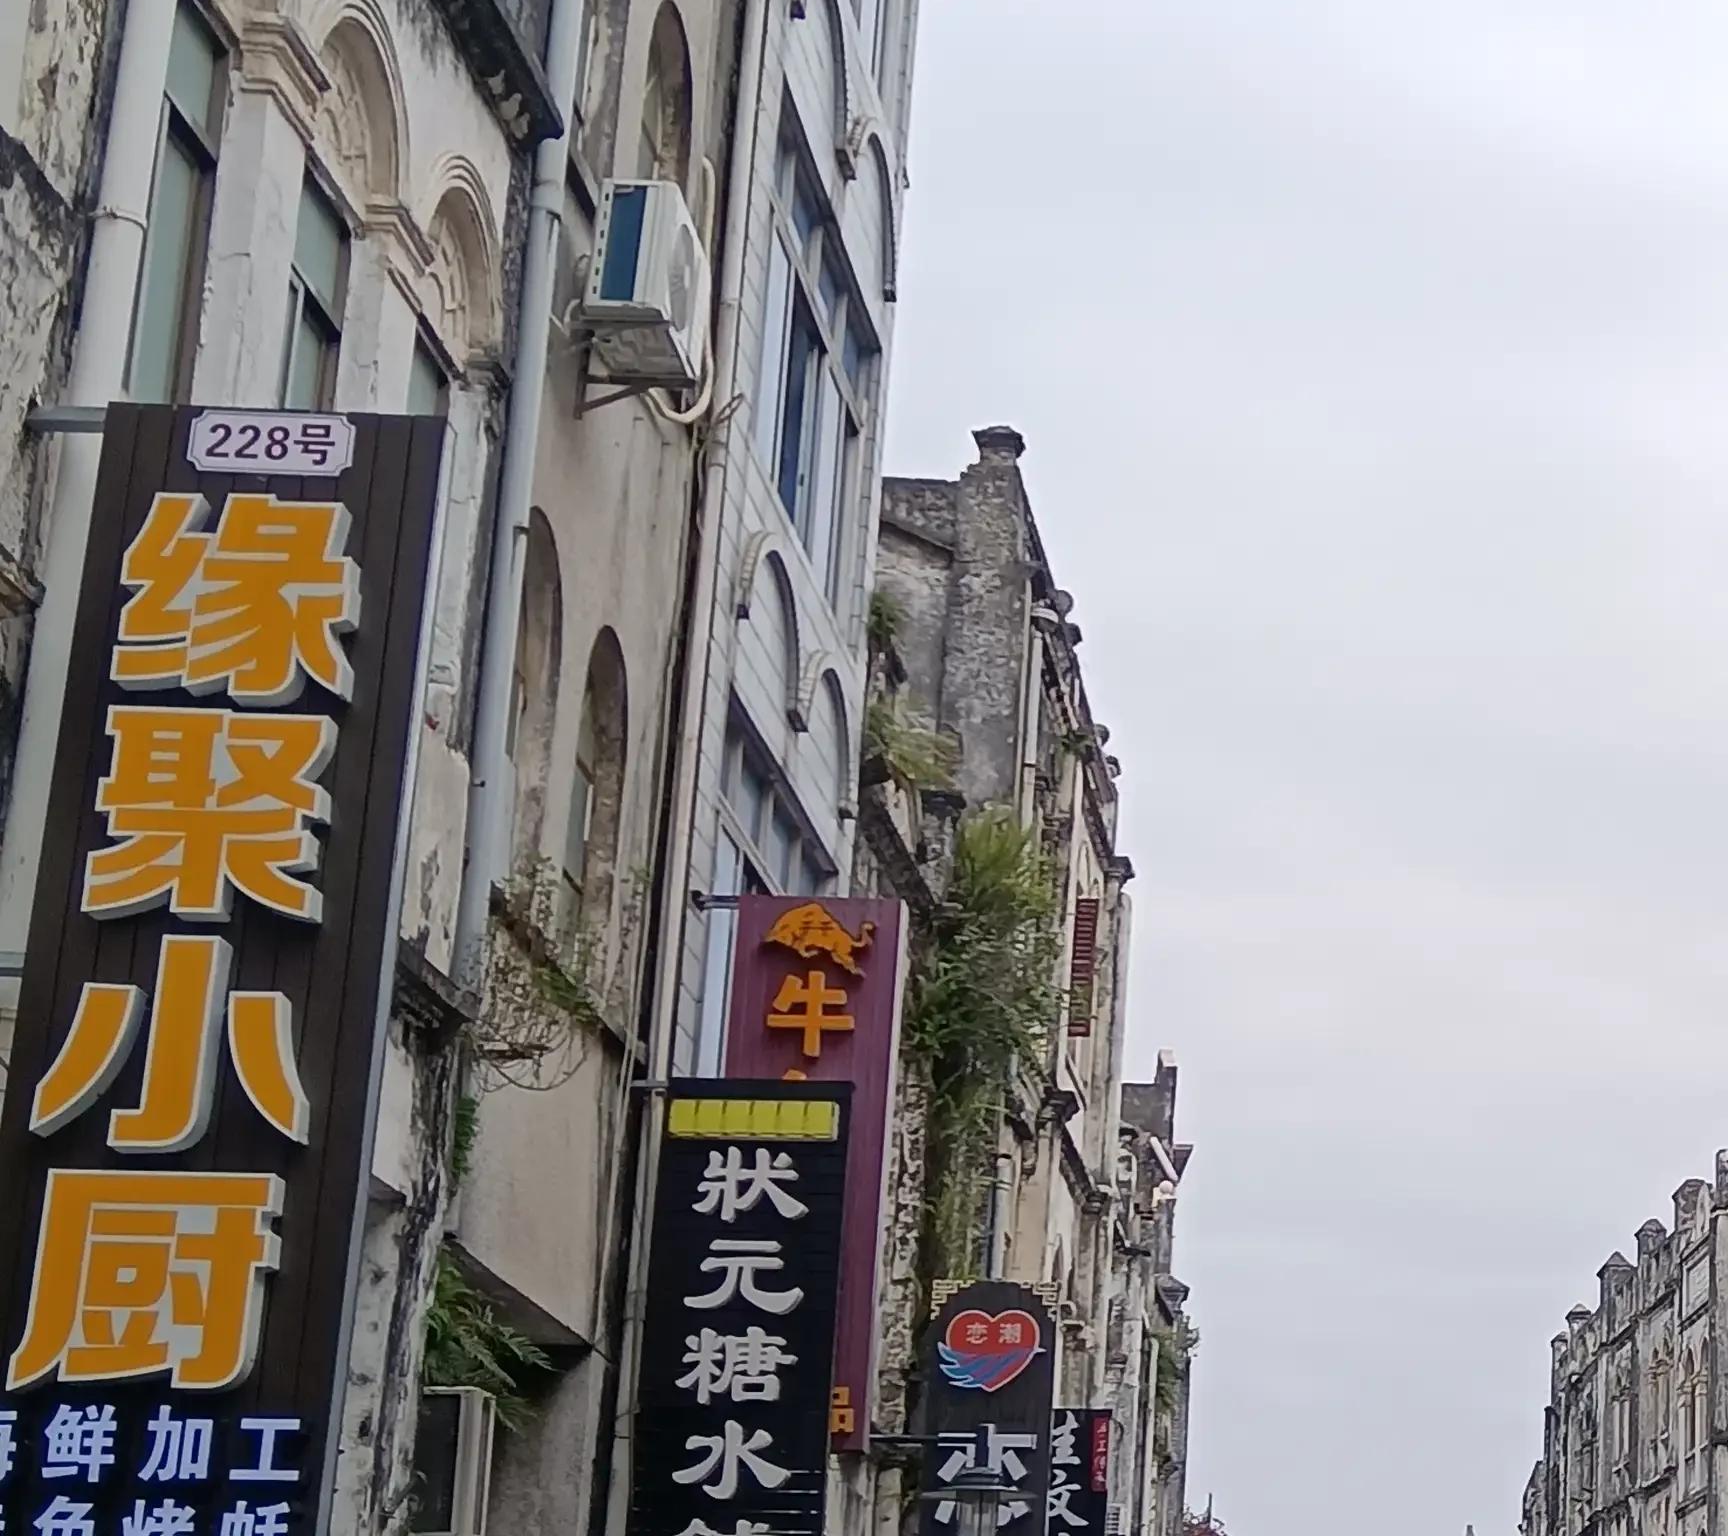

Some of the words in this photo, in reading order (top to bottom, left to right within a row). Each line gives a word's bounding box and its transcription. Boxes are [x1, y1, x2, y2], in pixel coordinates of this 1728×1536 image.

[204, 422, 336, 466] 228号
[6, 492, 363, 1391] 缘聚小厨
[0, 1404, 301, 1484] 鲜加工
